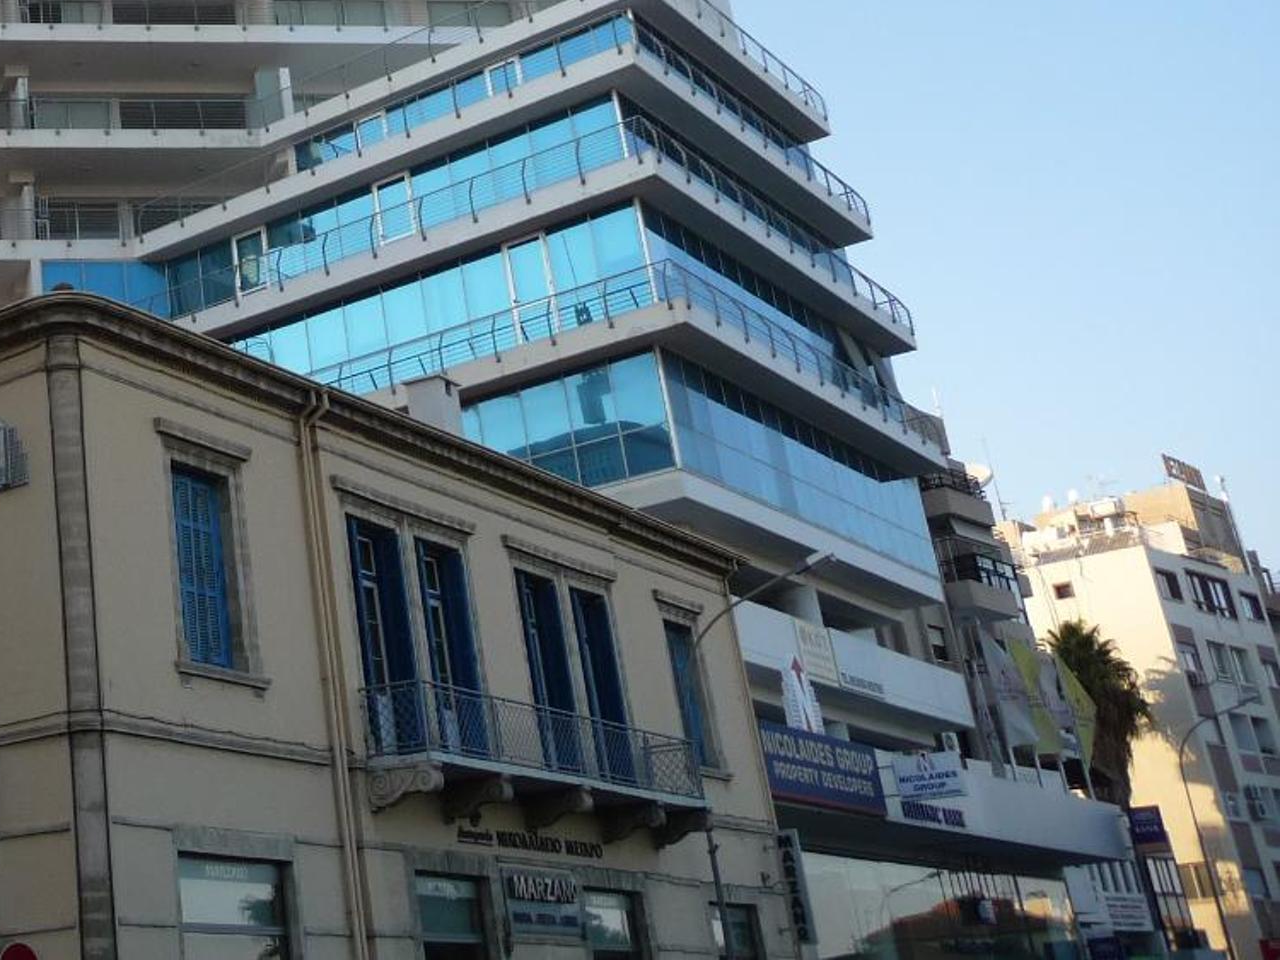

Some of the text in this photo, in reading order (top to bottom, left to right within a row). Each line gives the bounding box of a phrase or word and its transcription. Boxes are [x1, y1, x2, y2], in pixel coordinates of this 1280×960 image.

[761, 730, 873, 775] NICOLAIDES GROUP
[772, 760, 875, 798] PROPERTY DEVELOPERS
[898, 770, 958, 784] NICOLAIDES
[913, 782, 946, 792] GROUP
[512, 874, 578, 904] MARZANO
[777, 834, 809, 941] MARZANO
